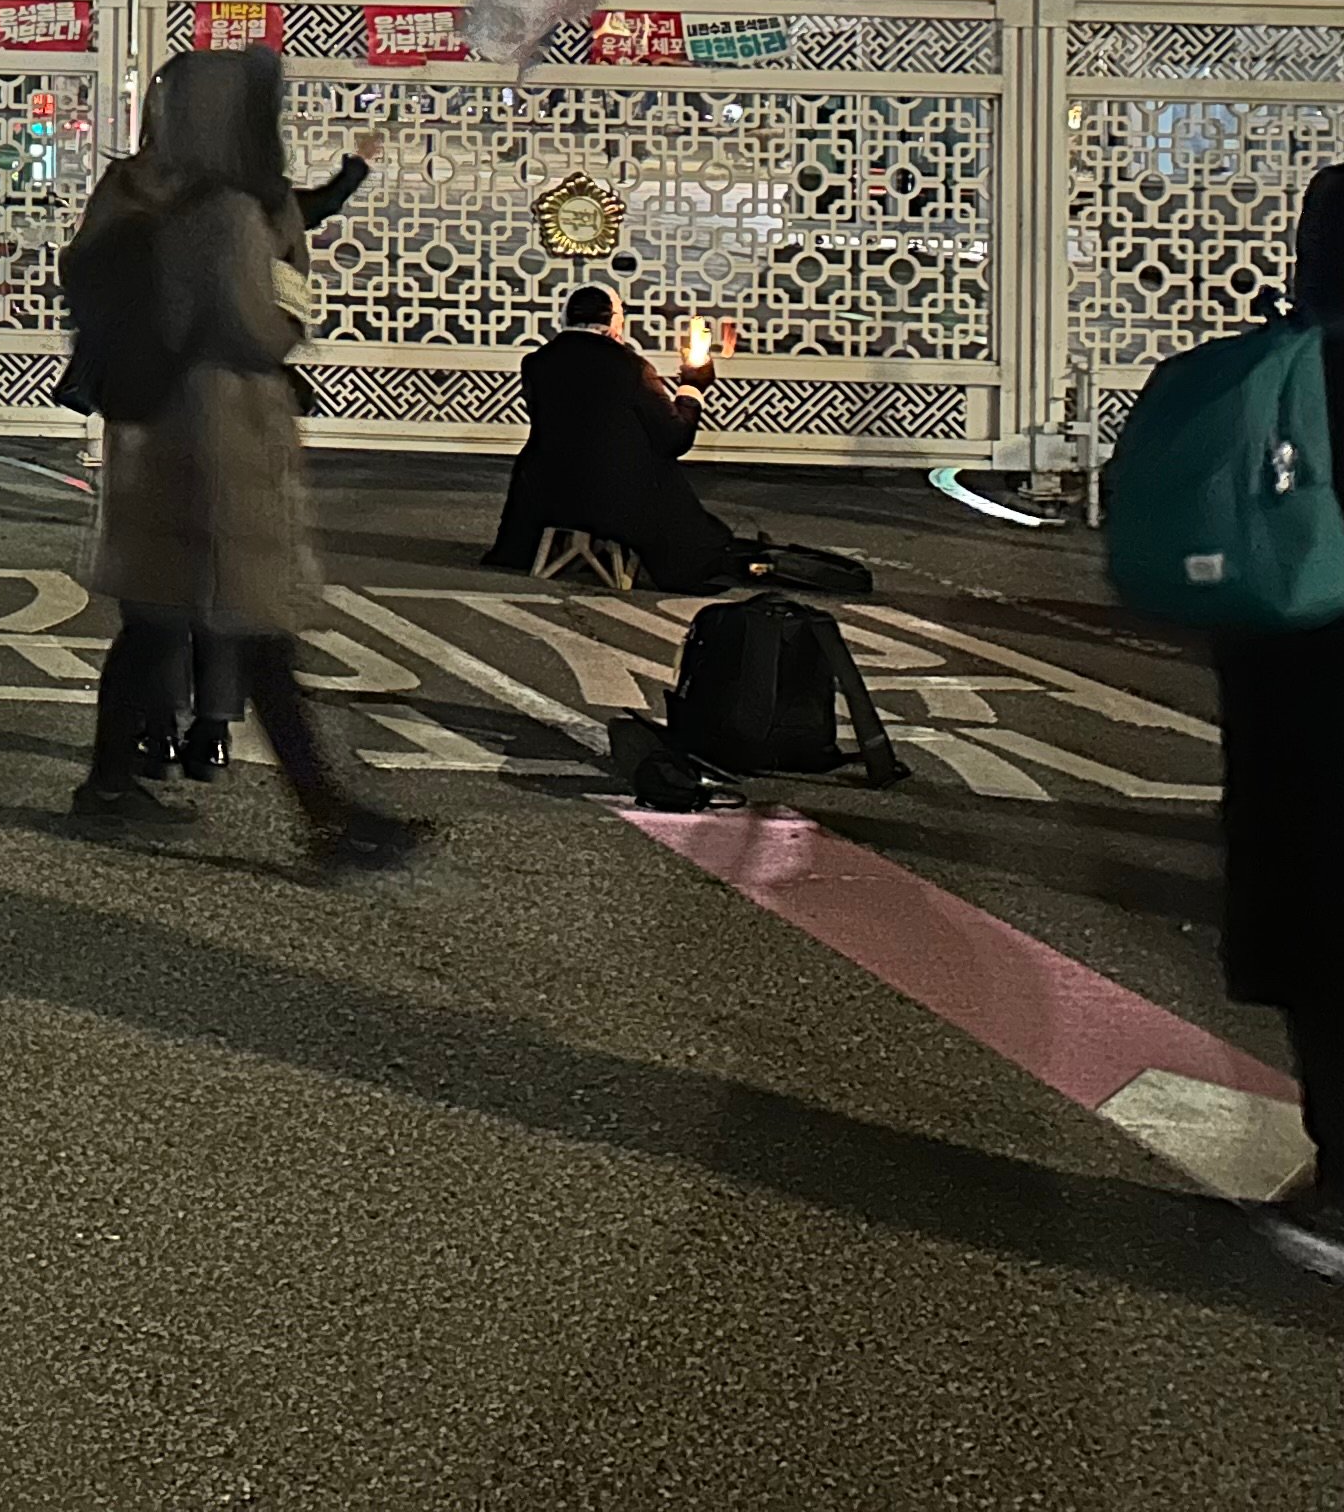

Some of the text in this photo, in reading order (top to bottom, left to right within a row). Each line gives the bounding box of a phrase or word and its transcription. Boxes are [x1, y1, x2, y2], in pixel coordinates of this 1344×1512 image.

[211, 2, 267, 19] 내란죄
[210, 18, 267, 39] 윤석열
[374, 11, 455, 35] 윤석열을
[686, 16, 781, 37] 내란수괴 윤석열을
[375, 31, 462, 55] 거부한다!
[689, 30, 788, 61] 탄핵하라
